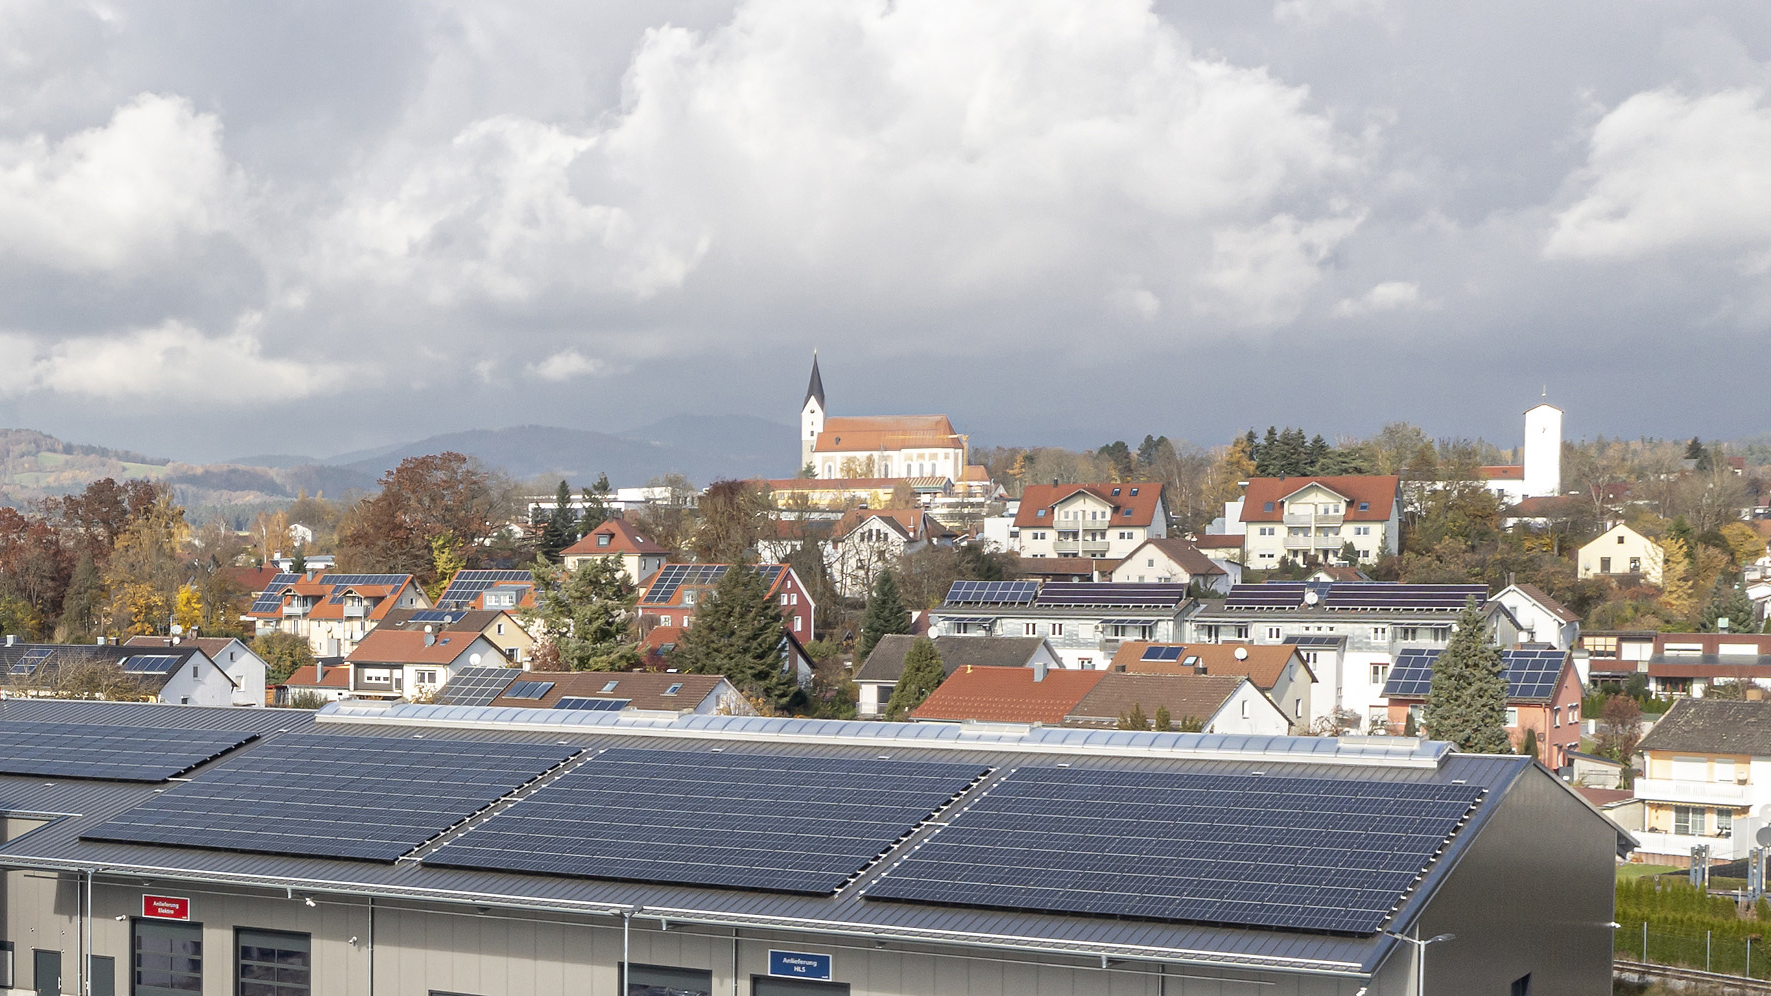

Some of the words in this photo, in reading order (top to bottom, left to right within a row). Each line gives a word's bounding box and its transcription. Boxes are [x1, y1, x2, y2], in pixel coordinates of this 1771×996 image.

[153, 900, 179, 910] Anlieferung
[158, 907, 175, 915] Elektro
[782, 957, 818, 968] Anlieferung
